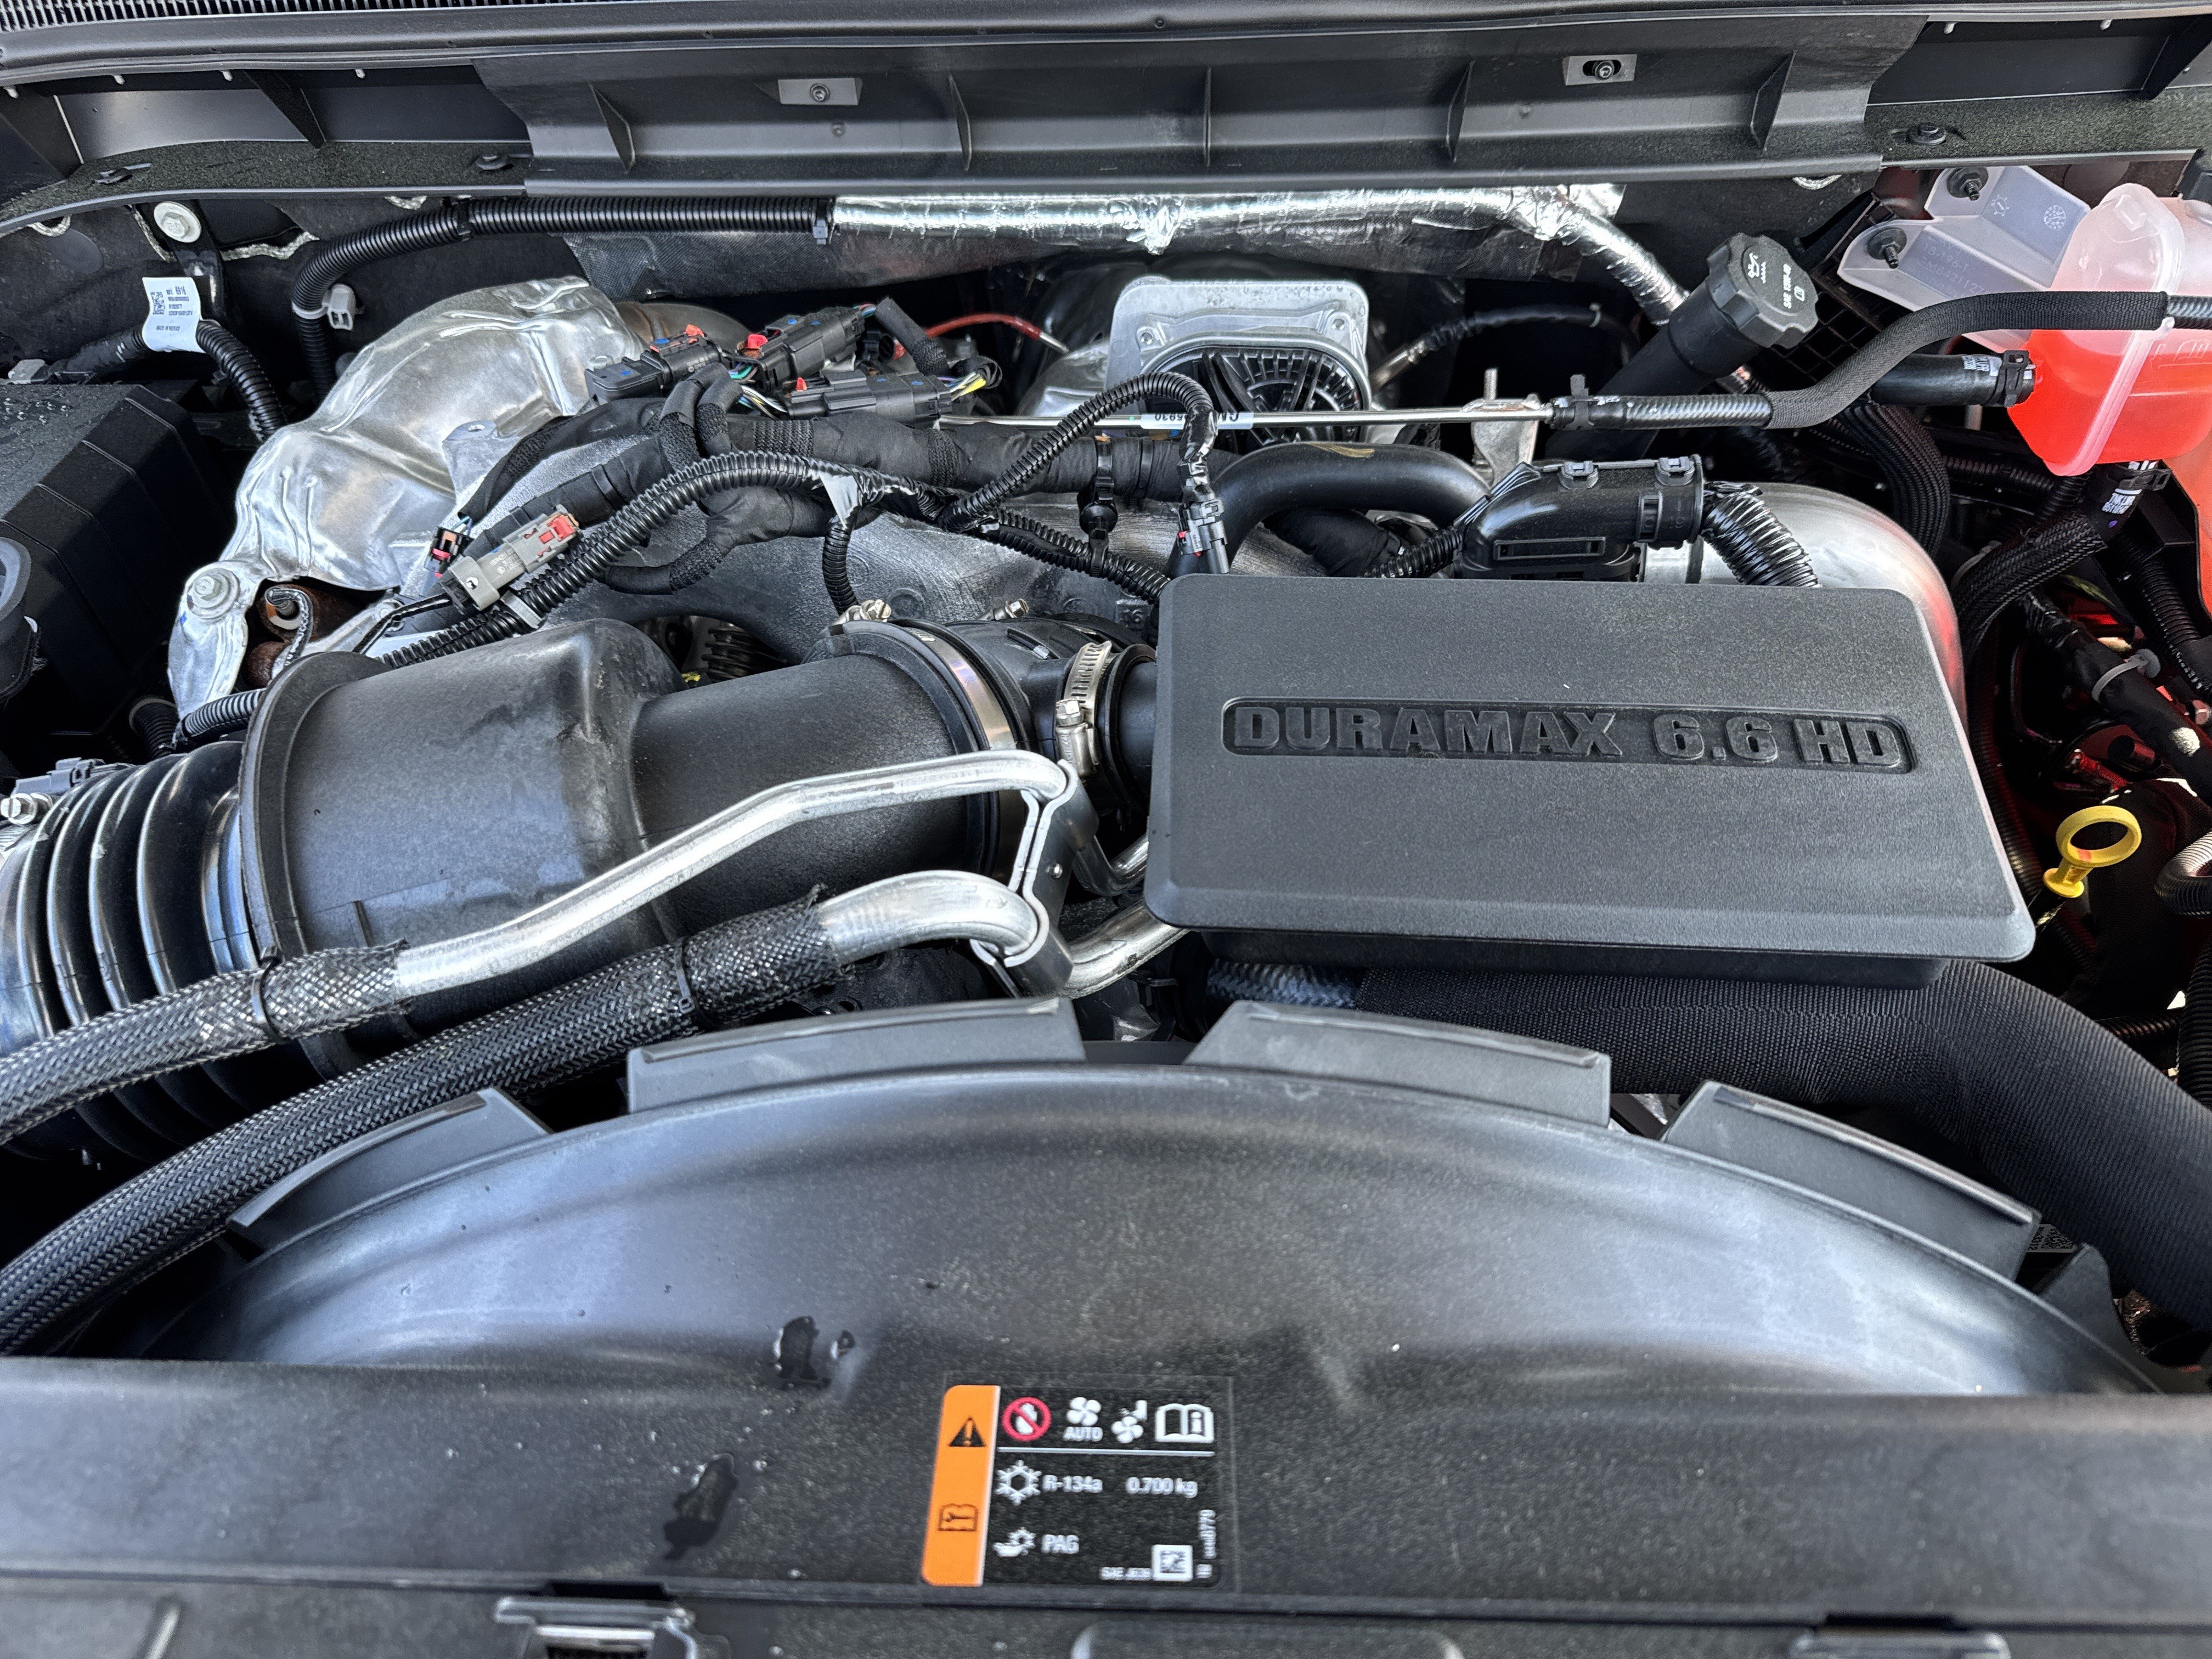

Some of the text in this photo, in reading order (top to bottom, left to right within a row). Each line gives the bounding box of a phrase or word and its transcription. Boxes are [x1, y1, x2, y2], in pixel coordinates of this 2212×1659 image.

[1916, 256, 1991, 295] GM8421127
[1233, 706, 1903, 770] DURAMAX 6.6 HD
[1063, 1426, 1103, 1442] AUTO
[1042, 1474, 1198, 1498] R-134a 0.700 kg
[1042, 1534, 1079, 1554] PAG
